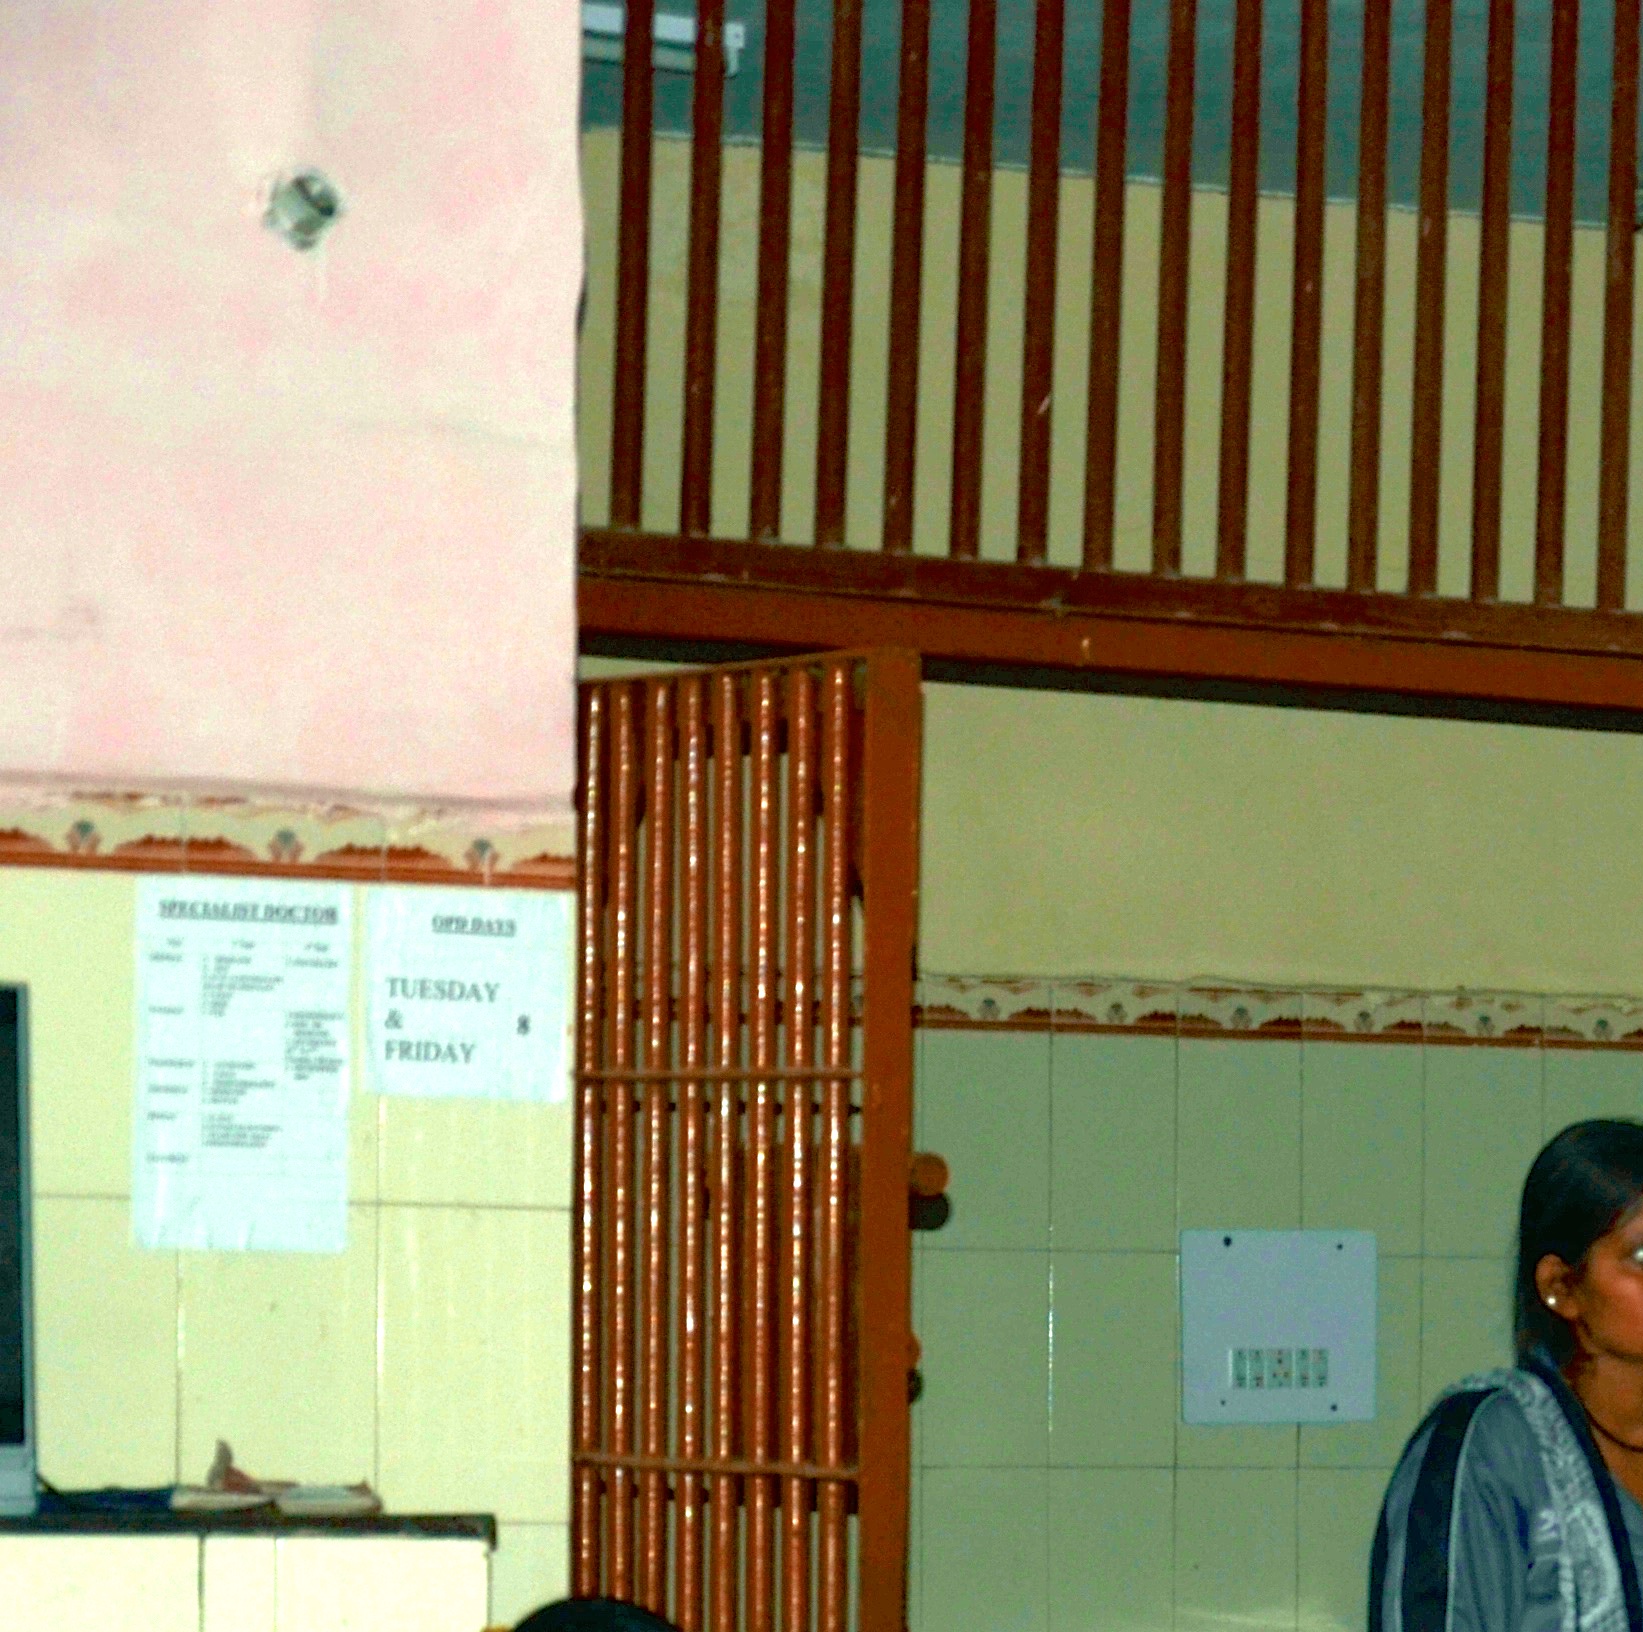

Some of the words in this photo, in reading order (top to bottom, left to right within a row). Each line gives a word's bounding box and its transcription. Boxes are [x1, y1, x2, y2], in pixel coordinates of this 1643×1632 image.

[159, 899, 259, 920] SPECIALIST
[386, 976, 500, 1003] TUESDAY
[384, 1008, 403, 1029] &
[385, 1038, 476, 1064] FRIDAY
